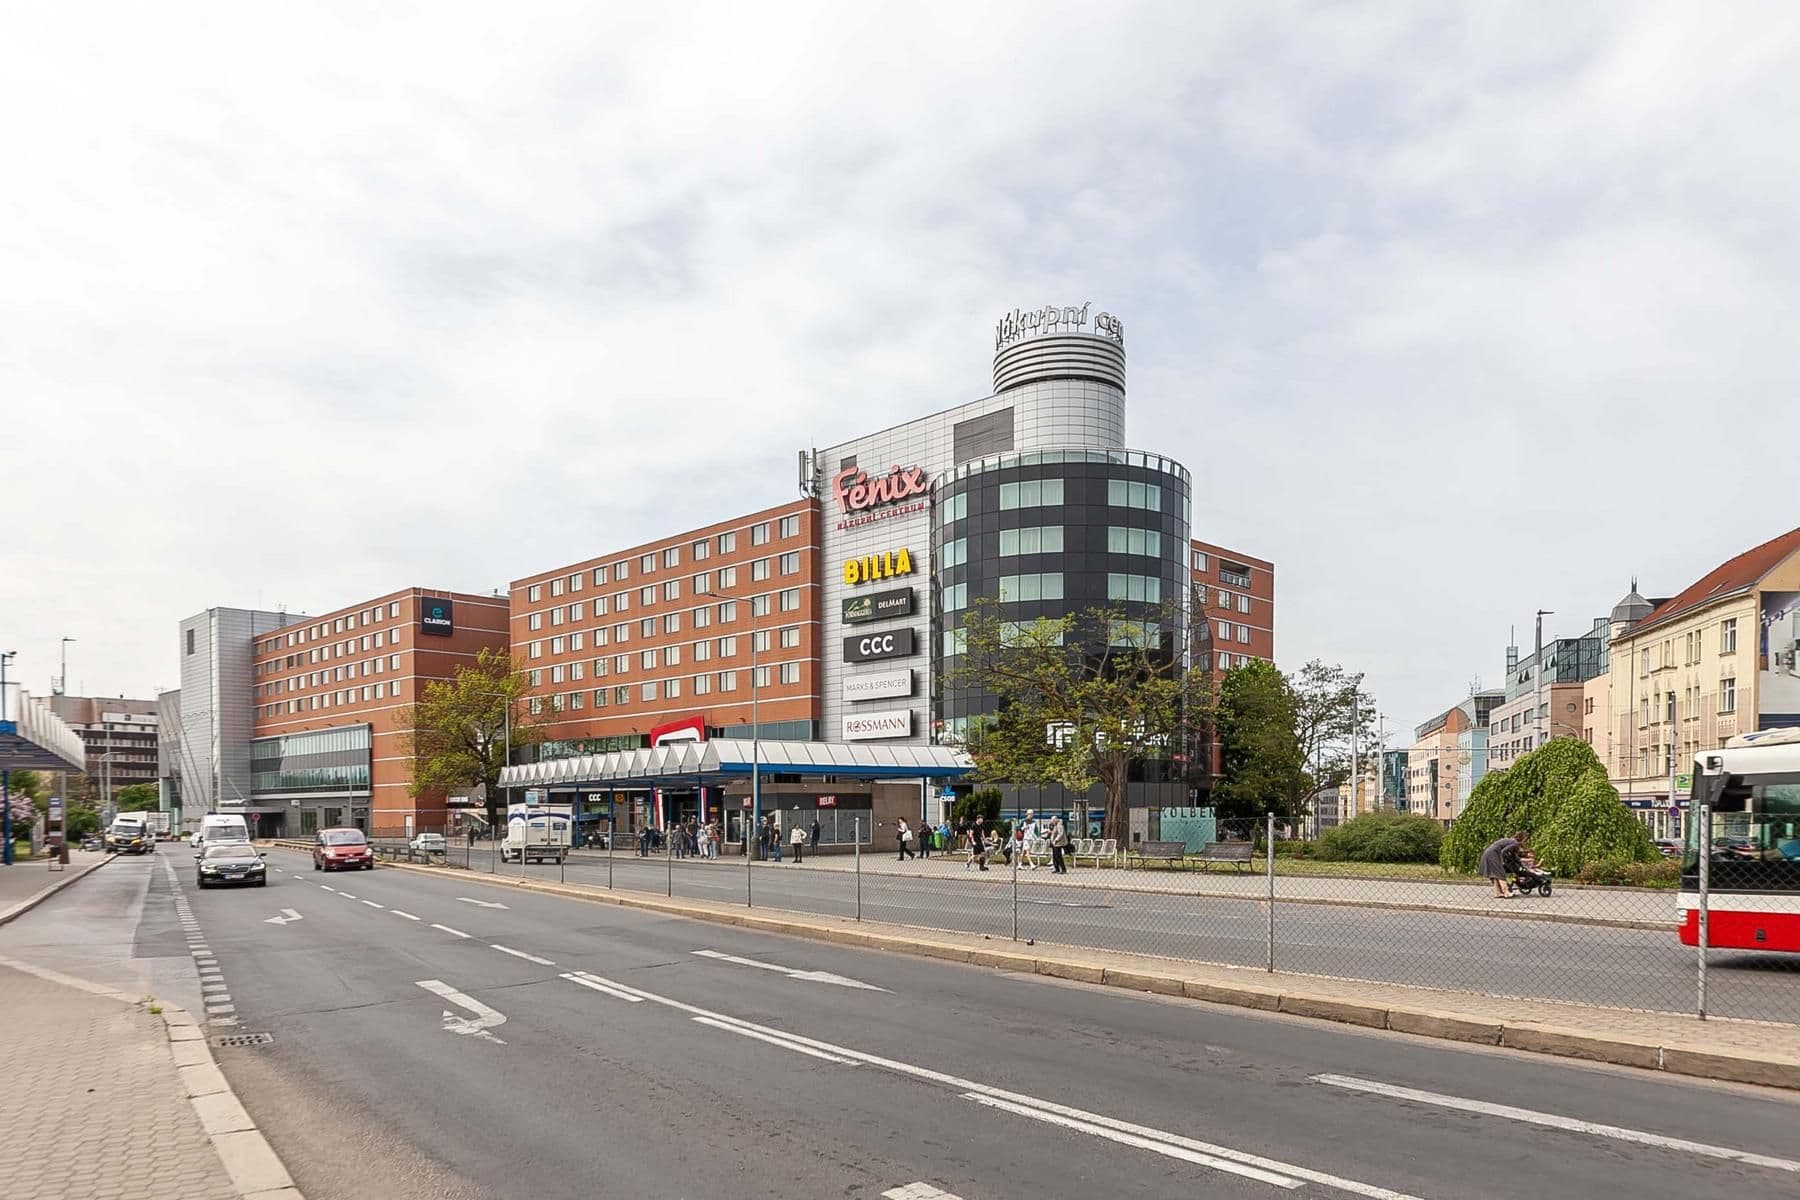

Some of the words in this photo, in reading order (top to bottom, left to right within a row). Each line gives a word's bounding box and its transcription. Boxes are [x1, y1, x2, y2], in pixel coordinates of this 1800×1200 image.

[832, 464, 926, 514] Fénix
[880, 502, 925, 520] CENTRUM
[844, 548, 912, 585] BILLA
[878, 598, 907, 609] DELMART
[860, 635, 894, 655] CCC
[847, 682, 869, 692] MARKS
[875, 678, 907, 690] SPENCER
[847, 717, 906, 733] ROSSMANN
[588, 793, 601, 802] CCC
